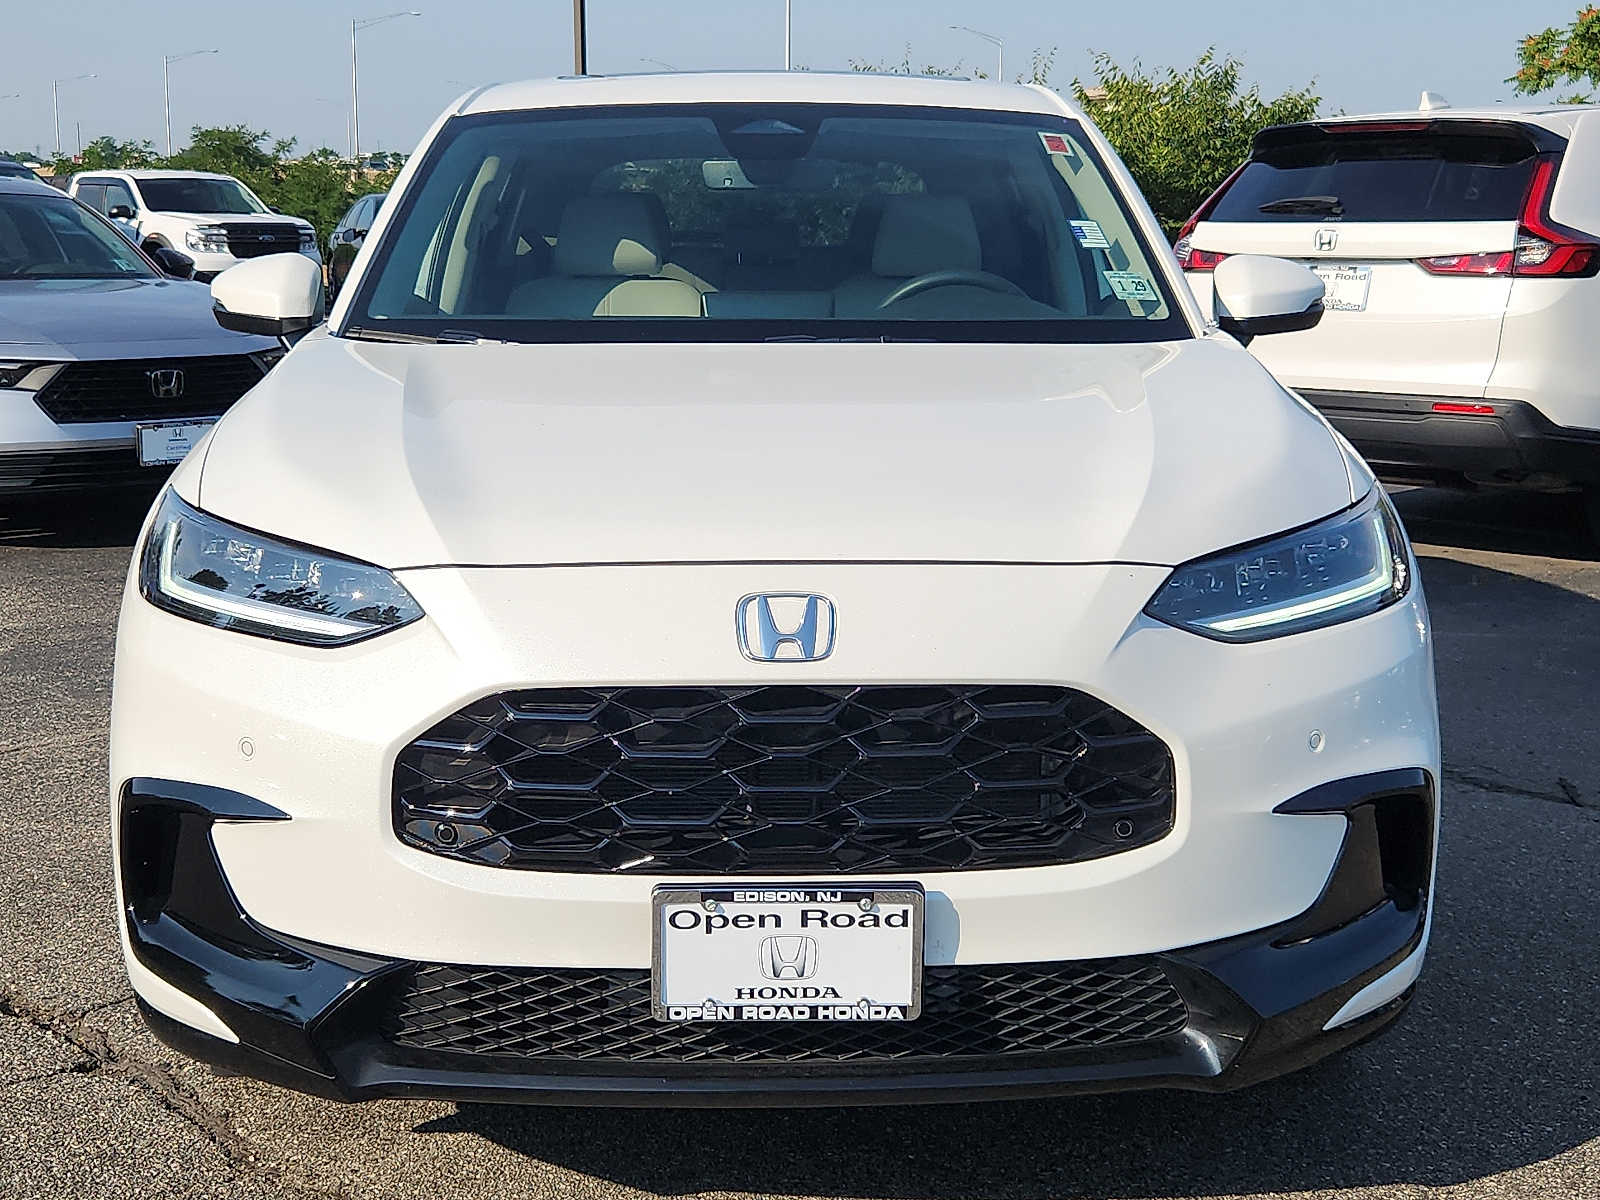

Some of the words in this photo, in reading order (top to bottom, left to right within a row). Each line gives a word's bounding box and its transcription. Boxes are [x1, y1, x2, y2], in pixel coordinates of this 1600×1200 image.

[1117, 280, 1128, 291] 1
[1131, 280, 1147, 291] 29
[733, 891, 810, 902] EDISON,
[817, 891, 842, 902] NJ
[668, 909, 782, 935] Open
[800, 909, 909, 929] Road
[735, 986, 843, 1000] HONDA
[669, 1006, 735, 1020] OPEN
[742, 1006, 810, 1020] ROAD
[817, 1006, 904, 1020] HONDA
